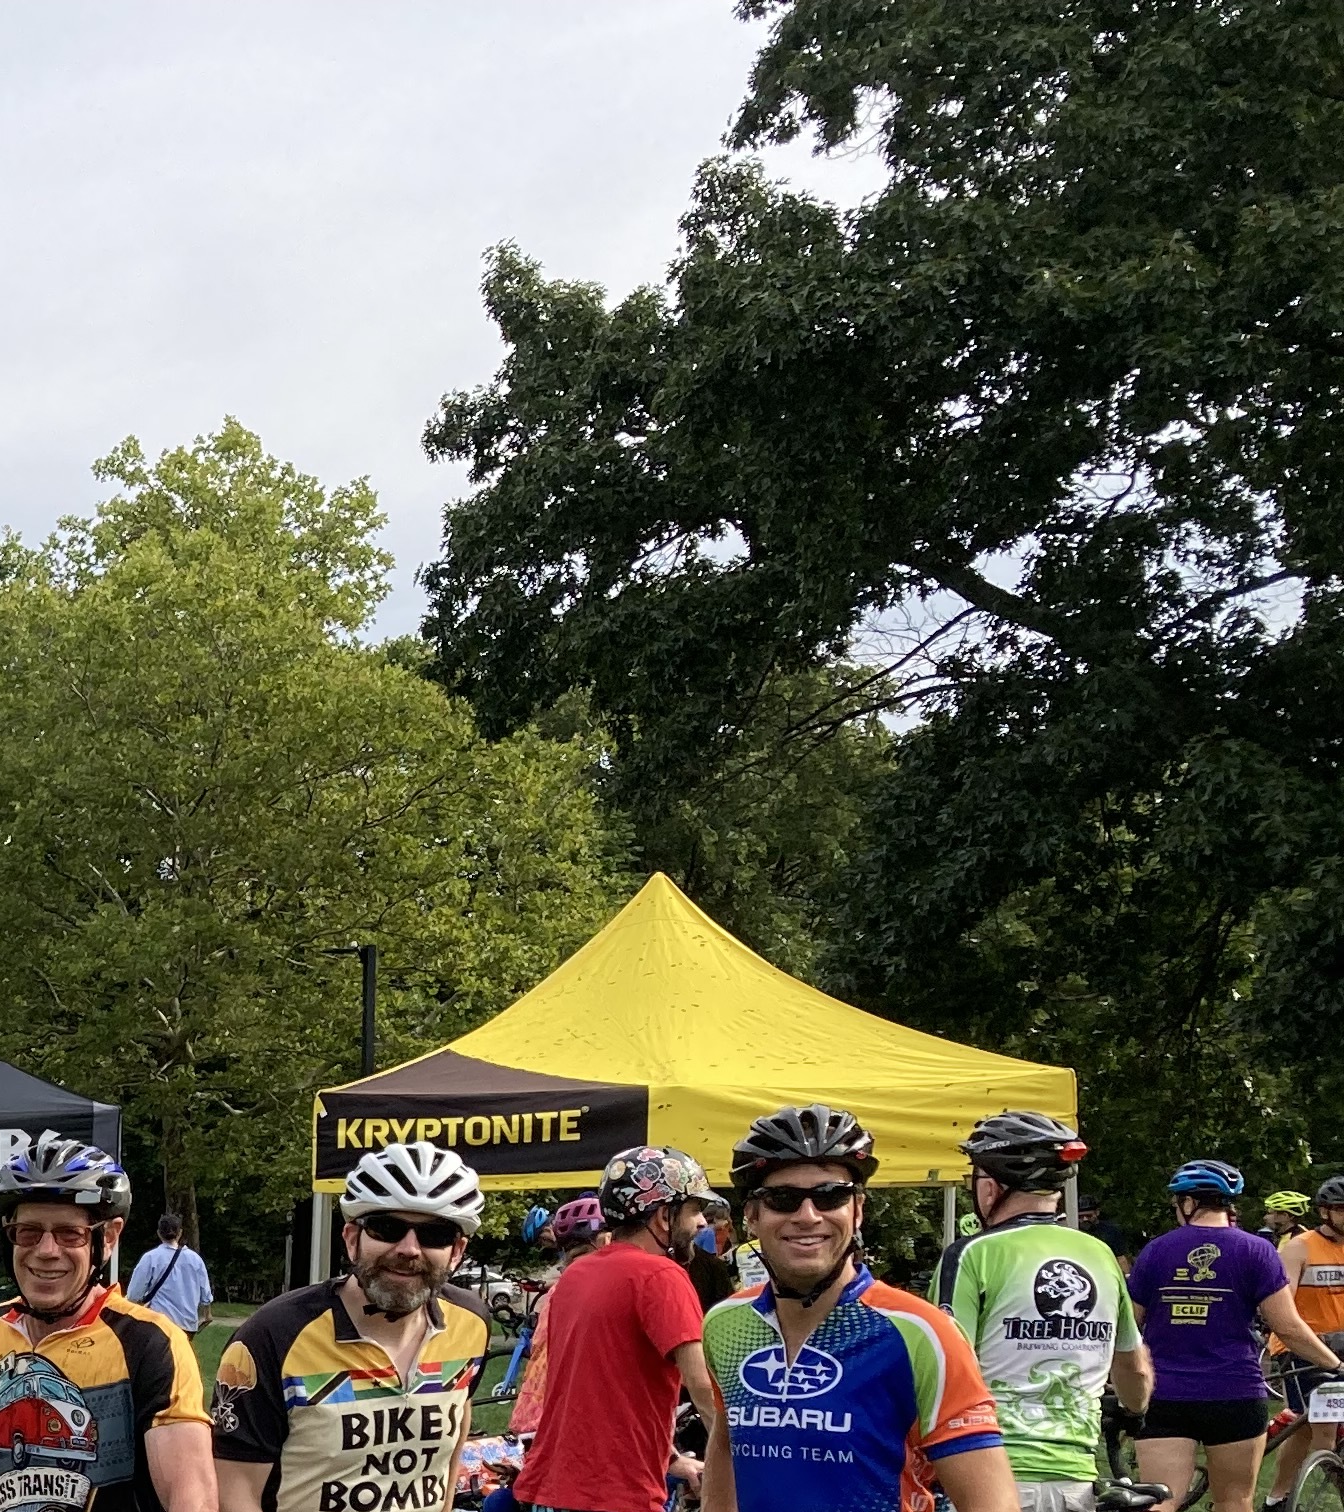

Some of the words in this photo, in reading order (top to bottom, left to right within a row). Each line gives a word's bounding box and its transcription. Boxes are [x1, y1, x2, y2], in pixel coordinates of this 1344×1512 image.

[337, 1109, 582, 1149] KRYPTONITE
[1003, 1317, 1053, 1340] TREE
[1059, 1317, 1114, 1341] HOUSE
[342, 1403, 458, 1450] BIKES
[727, 1405, 852, 1433] SUBARU
[361, 1447, 439, 1476] NOT
[730, 1443, 793, 1459] YCLING
[799, 1446, 854, 1463] TEAM
[17, 1473, 80, 1499] TRANSIT
[319, 1474, 445, 1512] BOMBS
